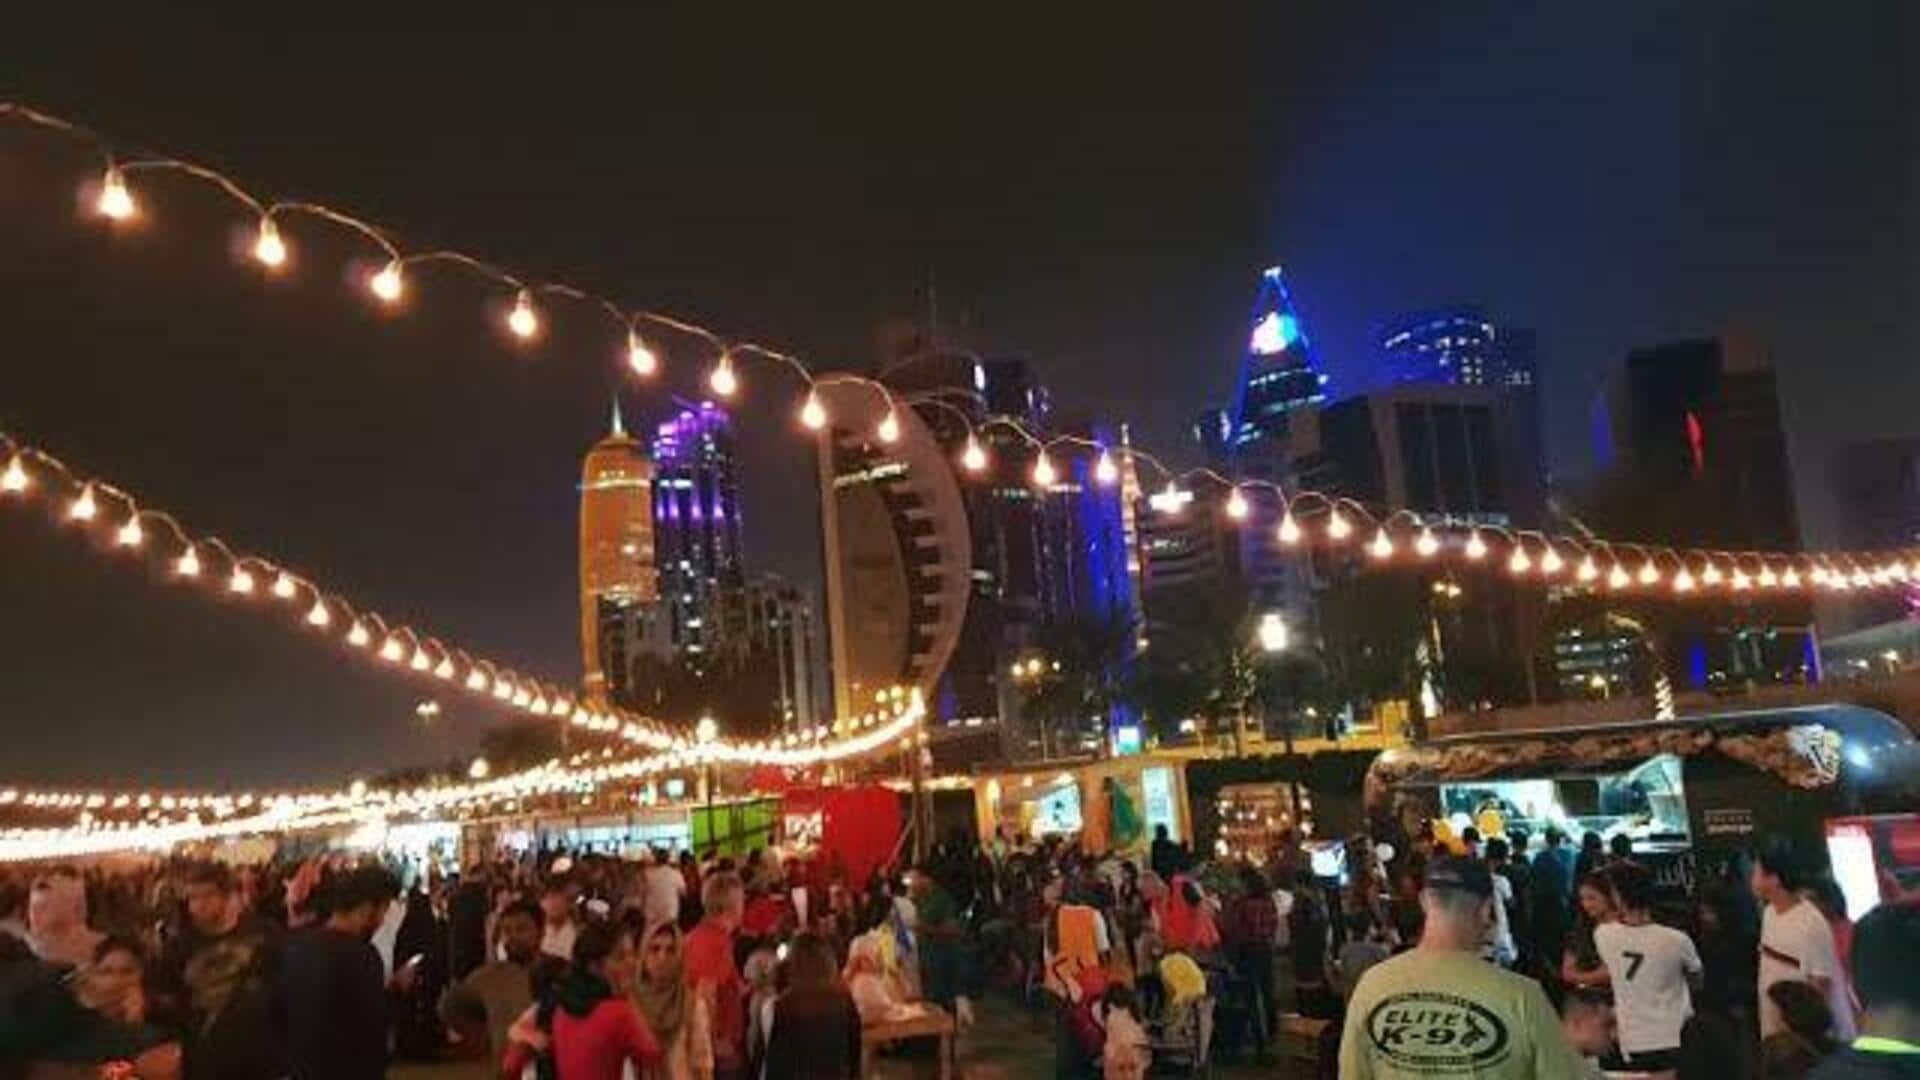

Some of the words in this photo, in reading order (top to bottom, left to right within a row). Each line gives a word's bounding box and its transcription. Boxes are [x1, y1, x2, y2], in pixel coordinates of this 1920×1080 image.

[1622, 951, 1645, 981] 7
[1385, 1010, 1460, 1026] ELITE
[1379, 1026, 1456, 1045] K-9
